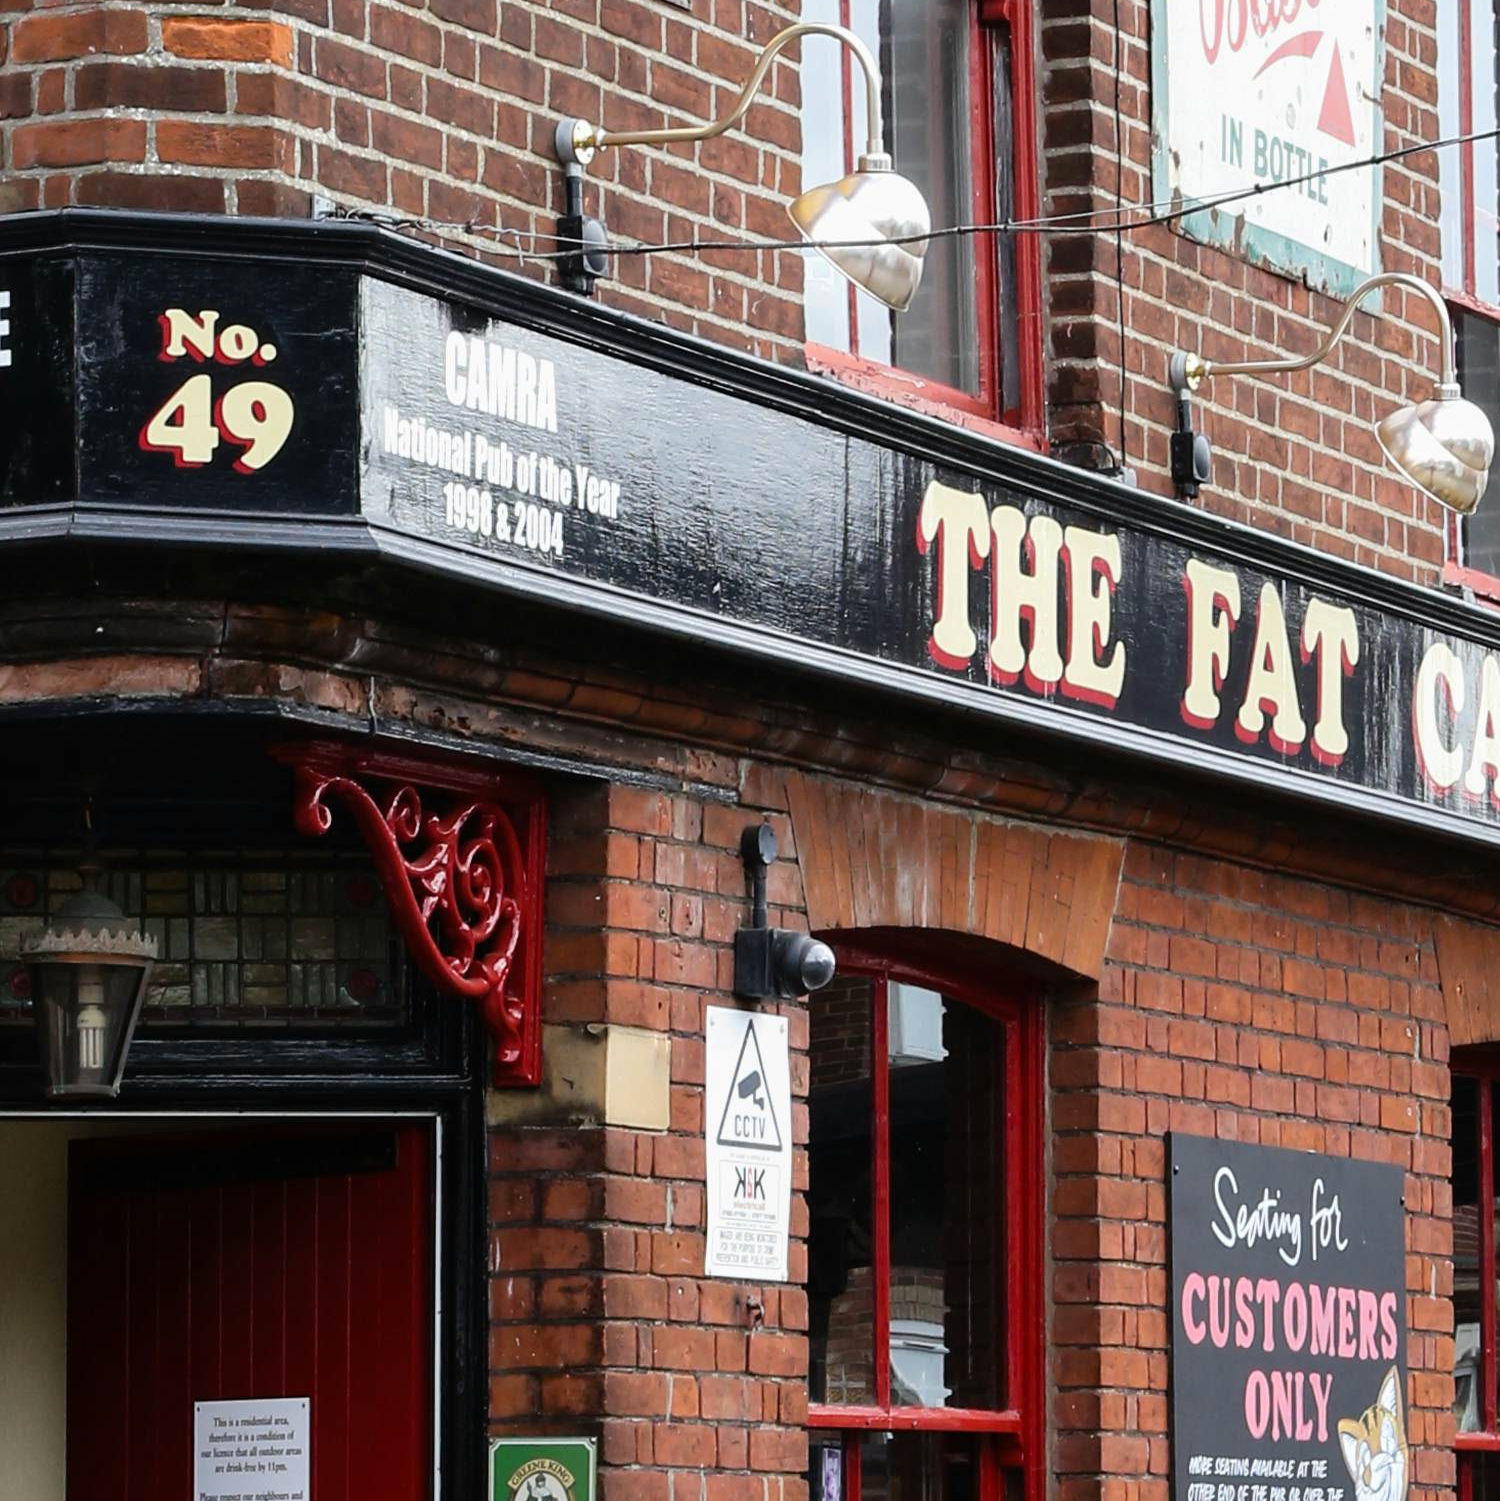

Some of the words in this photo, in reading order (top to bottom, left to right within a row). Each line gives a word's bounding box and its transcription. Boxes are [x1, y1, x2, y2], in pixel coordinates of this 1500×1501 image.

[1221, 114, 1243, 169] IN
[1255, 126, 1328, 205] BOTTLE
[160, 308, 277, 365] No.
[141, 374, 294, 472] 49
[445, 330, 557, 432] CAMRA
[384, 406, 471, 477] National
[475, 435, 512, 489] Pub
[516, 452, 537, 495] of
[539, 454, 572, 506] the
[575, 465, 620, 519] Year
[443, 482, 492, 536] 1998
[496, 503, 511, 543] &
[514, 502, 563, 555] 2004
[916, 481, 1126, 708] THE
[1180, 558, 1361, 765] FAT
[734, 1114, 766, 1139] CCTV
[1211, 1166, 1302, 1266] Seating
[1309, 1178, 1348, 1261] for
[1181, 1272, 1398, 1360] CUSTOMERS
[1244, 1369, 1334, 1443] ONLY
[511, 1460, 546, 1486] GREENE
[548, 1461, 571, 1485] KING
[1188, 1456, 1213, 1476] MORE
[1214, 1457, 1249, 1478] SEATING
[1250, 1458, 1295, 1479] AVAILABLE
[1297, 1460, 1310, 1479] AT
[1311, 1460, 1327, 1479] THE
